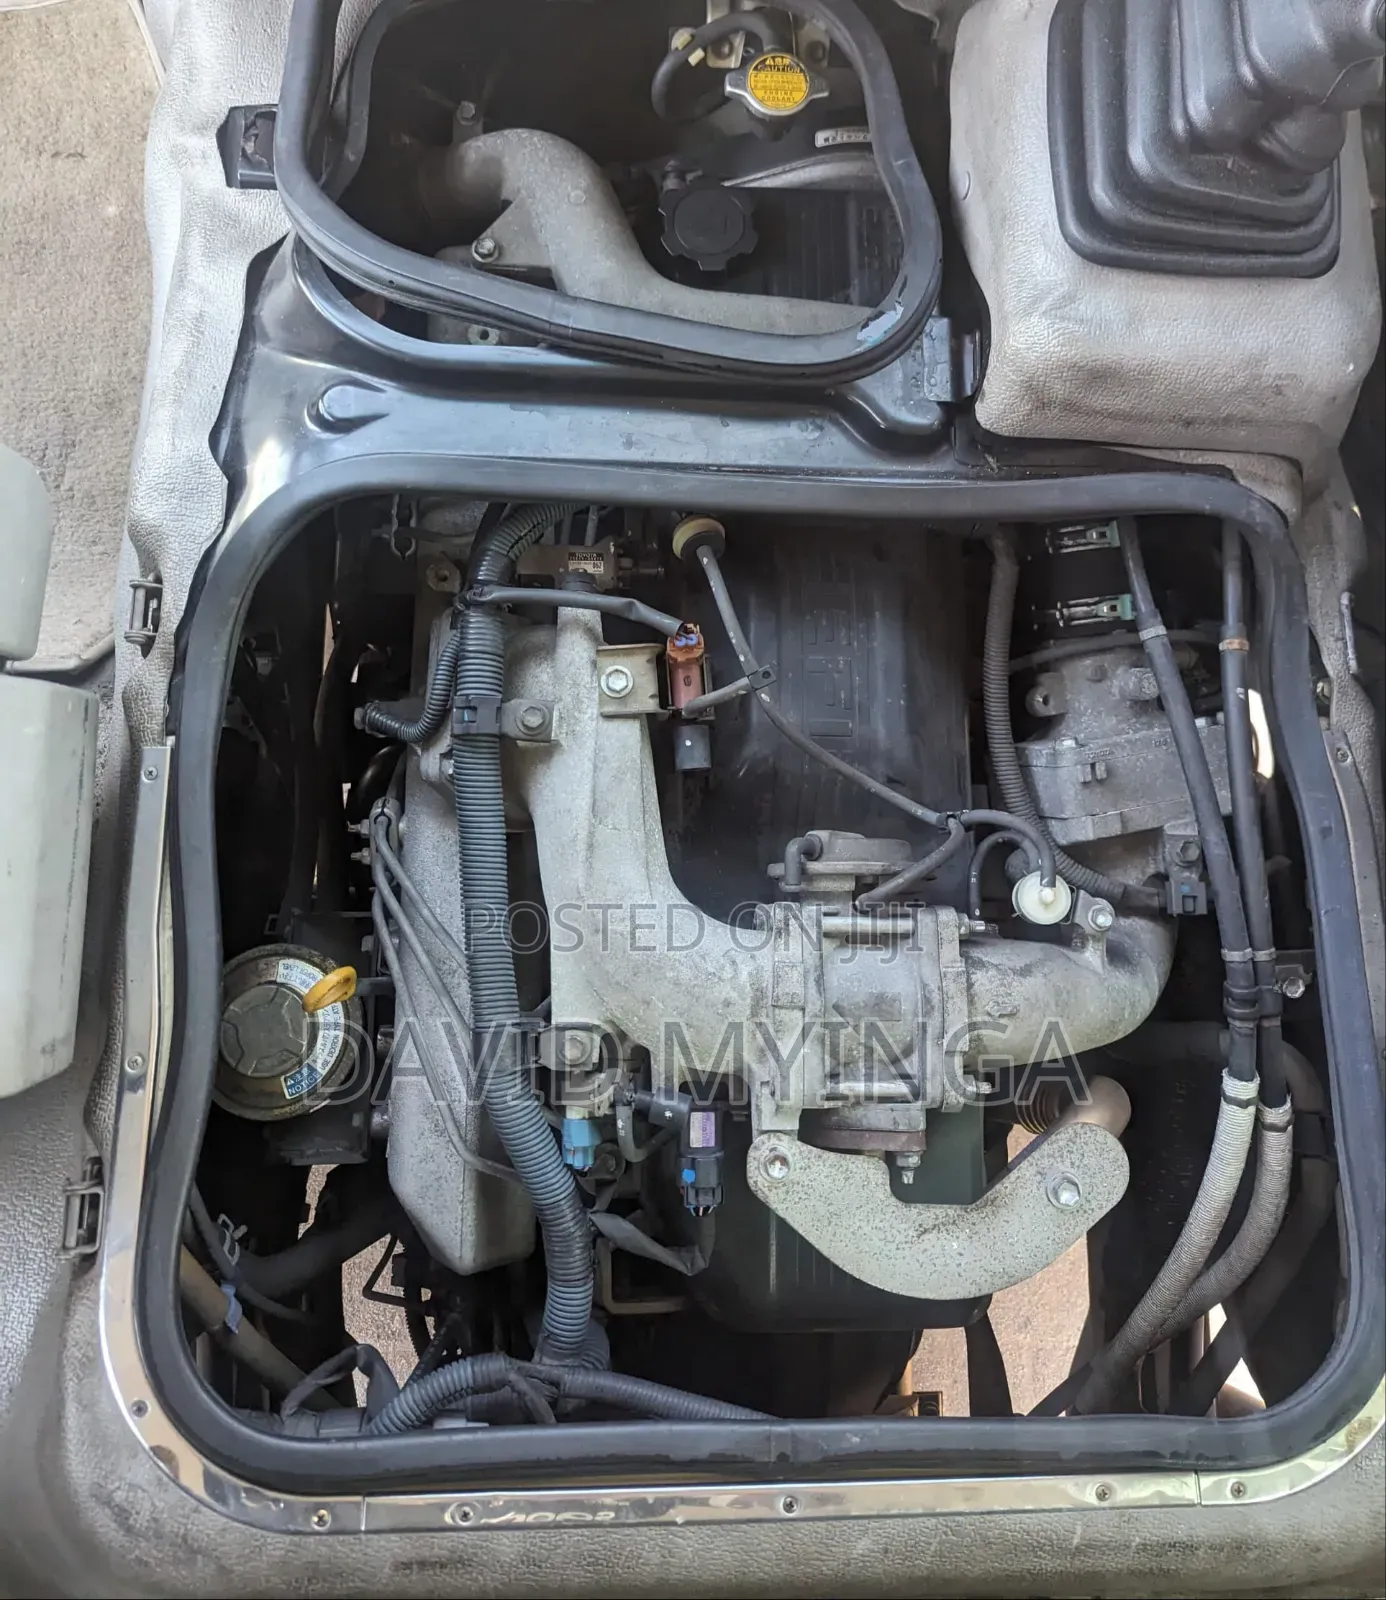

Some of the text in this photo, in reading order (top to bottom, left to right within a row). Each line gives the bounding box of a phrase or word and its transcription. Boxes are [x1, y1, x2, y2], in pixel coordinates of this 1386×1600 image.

[757, 64, 800, 73] CAUTION
[331, 1004, 340, 1015] ATF
[333, 1016, 342, 1032] TYPE
[327, 1034, 340, 1058] DEXRON
[320, 1058, 331, 1071] USE
[288, 1071, 320, 1095] NOTICE
